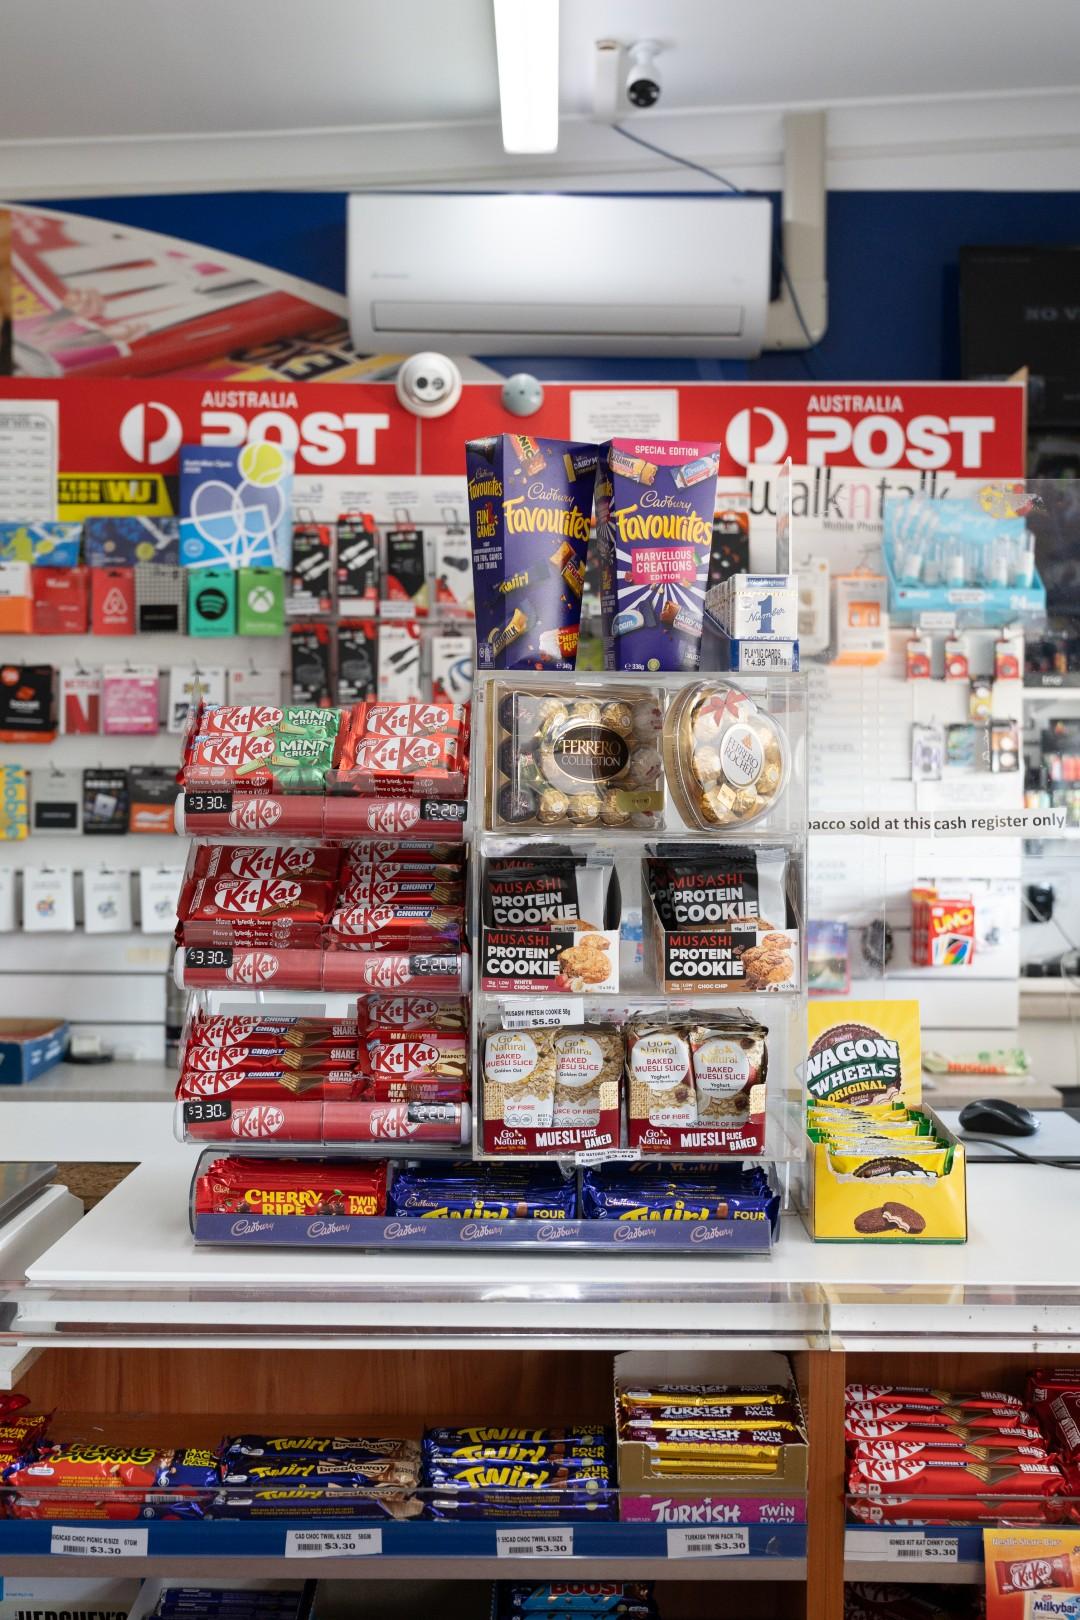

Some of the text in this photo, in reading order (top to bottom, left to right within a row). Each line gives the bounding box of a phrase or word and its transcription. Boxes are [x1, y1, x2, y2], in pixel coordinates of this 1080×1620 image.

[202, 391, 298, 409] AUSTRALIA
[807, 395, 903, 413] AUSTRALIA
[201, 412, 389, 466] POST
[807, 416, 995, 468] POST
[635, 445, 699, 457] SPECIAL EDITION
[468, 477, 503, 501] Favourites
[527, 482, 575, 506] Cadbury
[640, 490, 692, 513] Cadbury
[476, 510, 489, 525] FUN
[502, 496, 591, 542] Favourites
[616, 503, 712, 546] Favourites
[477, 523, 496, 538] GAMES
[635, 550, 692, 562] MARVELLOUS
[636, 561, 692, 573] CREATIONS
[650, 573, 680, 581] EDITION
[745, 607, 785, 623] Number
[757, 595, 775, 634] 1
[765, 649, 781, 658] CARDS
[220, 706, 281, 732] KitKat
[374, 704, 446, 736] KitKat
[209, 736, 272, 764] KitKat
[364, 737, 437, 769] KitKat
[562, 739, 621, 755] FERRERO
[561, 756, 621, 767] COLLECTION
[724, 749, 755, 779] ROCHER
[850, 816, 880, 830] sold
[885, 818, 900, 830] at
[904, 816, 931, 830] this
[934, 816, 967, 830] cash
[972, 814, 1028, 831] register
[1033, 813, 1065, 830] only
[239, 847, 312, 878] KitKat
[490, 876, 562, 894] MUSASHI
[674, 873, 744, 888] MUSASHI
[223, 880, 298, 911] KitKat
[492, 892, 562, 907] PROTEIN
[675, 887, 743, 903] PROTEIN
[493, 903, 578, 924] COOKIE
[675, 901, 758, 922] COOKIE
[338, 908, 391, 934] KitKat
[935, 909, 972, 932] UNO
[487, 933, 549, 945] MUSASHI
[670, 936, 732, 946] MUSASHI
[487, 946, 549, 959] PROTEIN
[670, 949, 731, 960] PROTEIN
[486, 960, 560, 976] COOKIE
[670, 961, 744, 976] COOKIE
[332, 1027, 356, 1036] SHARE
[376, 1044, 435, 1072] KitKat
[486, 1060, 511, 1068] MUESLI
[807, 1039, 898, 1081] WAGON
[810, 1063, 897, 1096] WHEELS
[828, 1080, 887, 1102] ORIGINAL
[494, 1137, 527, 1146] Natural
[501, 1130, 514, 1138] Go
[535, 1129, 580, 1147] MUESLI
[581, 1129, 597, 1138] SLICE
[584, 1134, 612, 1149] BAKED
[639, 1136, 671, 1145] Natural
[680, 1132, 727, 1148] MUESLI
[726, 1132, 742, 1140] SLICE
[730, 1137, 757, 1150] BAKED
[245, 1189, 322, 1207] CHERRY
[348, 1195, 378, 1206] TWIN
[262, 1203, 306, 1215] RIPE
[533, 1210, 565, 1218] FOUR
[734, 1211, 765, 1220] FOUR
[230, 1221, 274, 1236] Cadbury
[307, 1221, 351, 1238] Cadbury
[383, 1223, 427, 1240] Cadbury
[459, 1223, 503, 1241] Cadbury
[536, 1225, 580, 1242] Cadbury
[614, 1226, 657, 1242] Cadbury
[690, 1226, 733, 1243] Cadbury
[452, 1444, 546, 1464] Twirl
[249, 1463, 389, 1478] Twirl breakaway
[454, 1465, 549, 1489] Twirl
[90, 1546, 121, 1554] $3.30
[714, 1542, 746, 1550] $3.30
[1034, 1600, 1077, 1614] Milkybar
